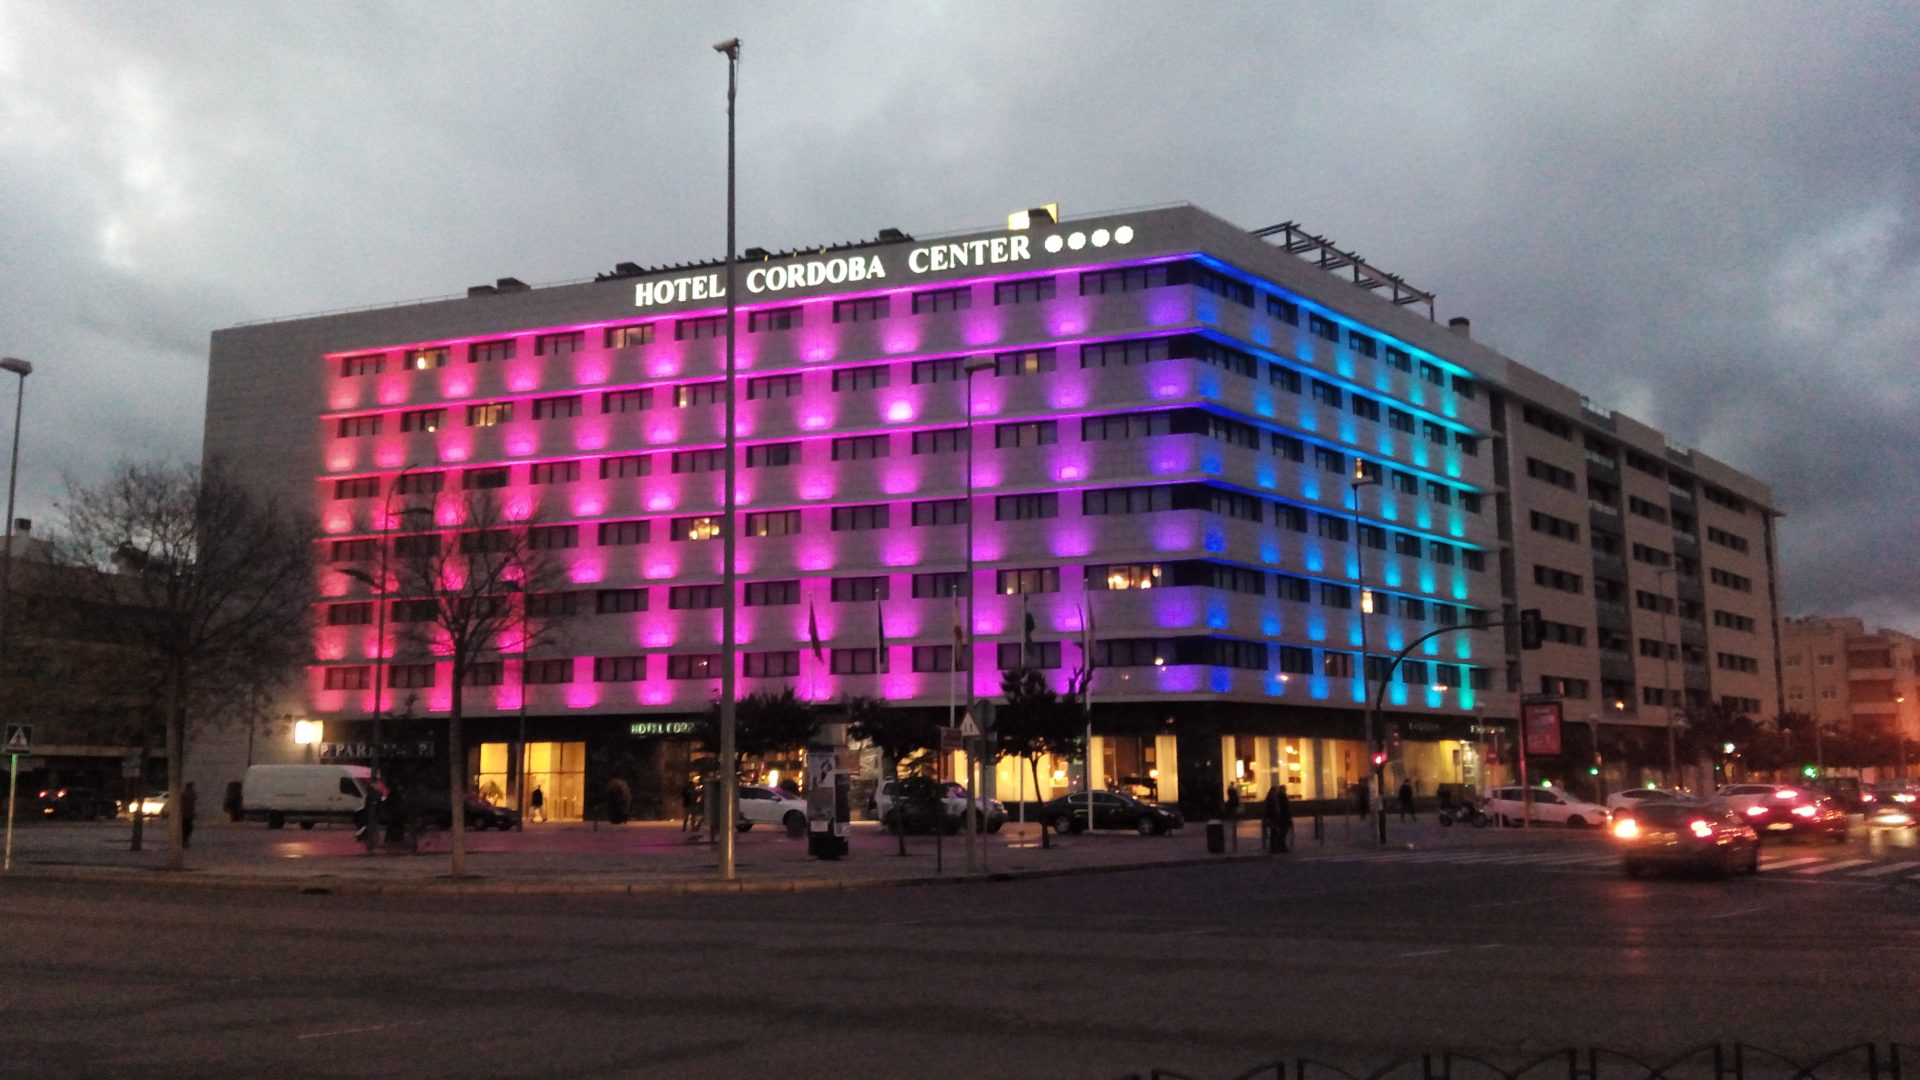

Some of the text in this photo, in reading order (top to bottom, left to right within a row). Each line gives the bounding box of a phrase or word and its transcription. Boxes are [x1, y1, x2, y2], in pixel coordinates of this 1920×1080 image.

[635, 235, 1032, 307] HOTEL CORDOBA CENTER
[631, 722, 664, 734] HOTEL
